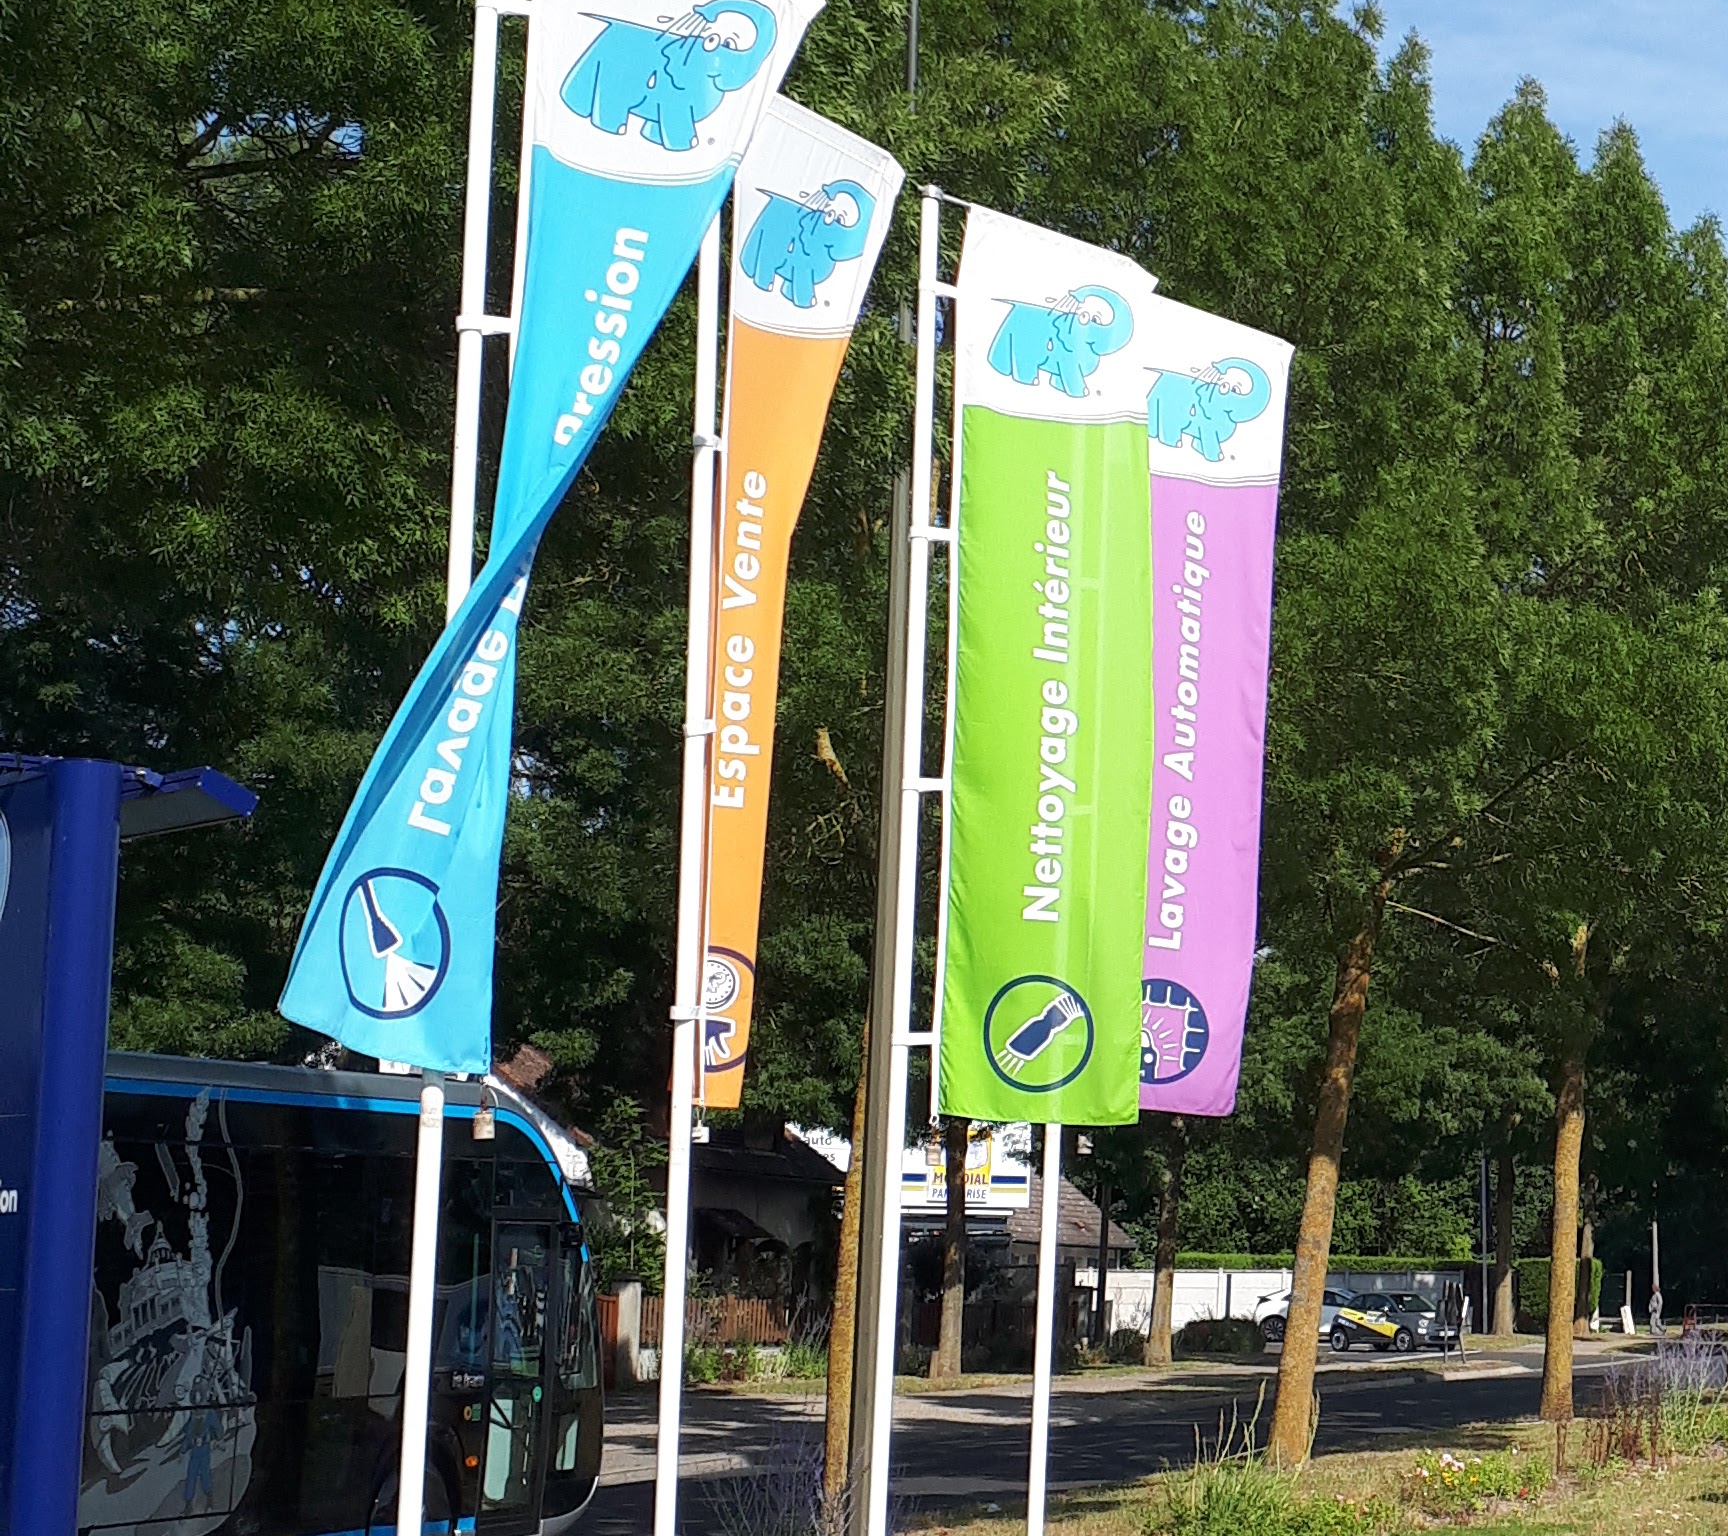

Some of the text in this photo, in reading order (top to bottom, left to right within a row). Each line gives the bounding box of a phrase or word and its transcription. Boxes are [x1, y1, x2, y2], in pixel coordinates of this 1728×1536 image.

[711, 470, 767, 809] Espace Vente
[1022, 469, 1079, 923] Nettoyage Intérieur
[1148, 510, 1211, 951] Lavage Automatique
[933, 1172, 989, 1185] MDIAL
